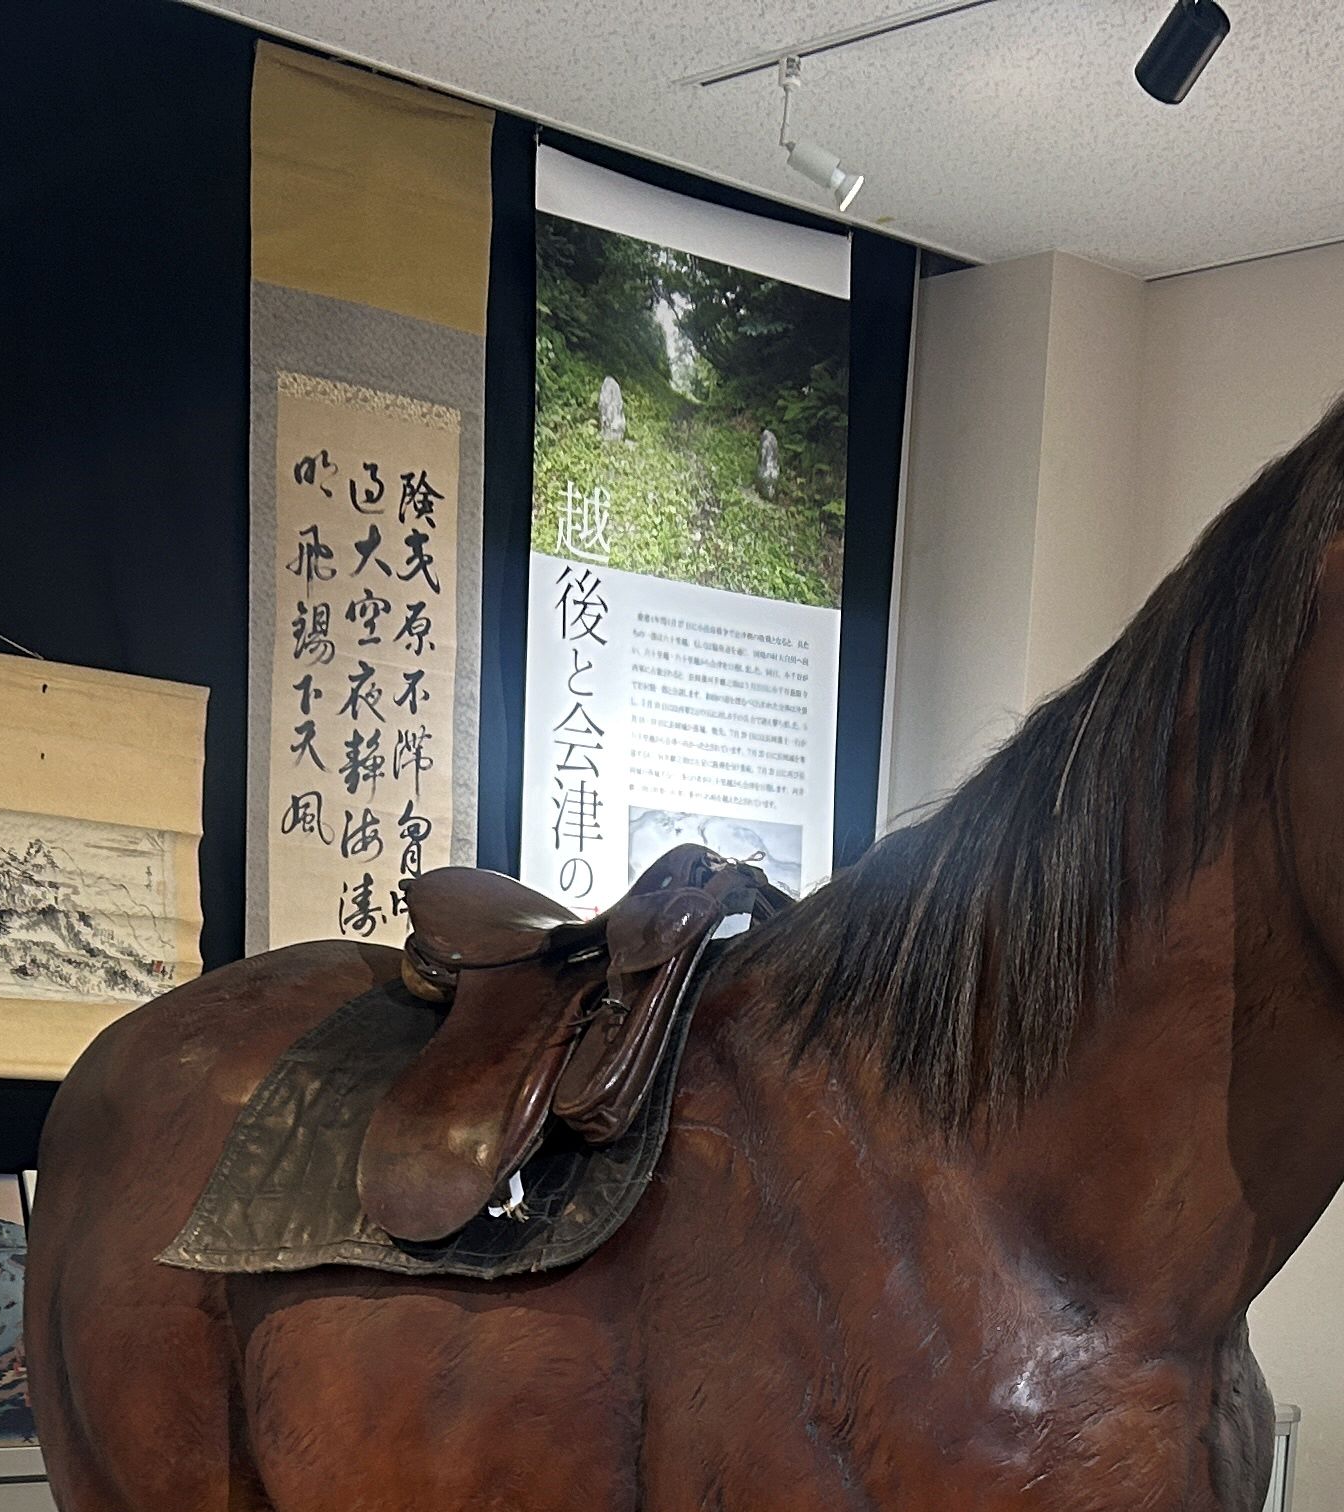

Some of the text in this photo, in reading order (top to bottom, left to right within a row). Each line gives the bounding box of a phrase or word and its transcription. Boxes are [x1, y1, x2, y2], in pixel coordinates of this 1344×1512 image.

[552, 481, 611, 923] 越後と会津の
